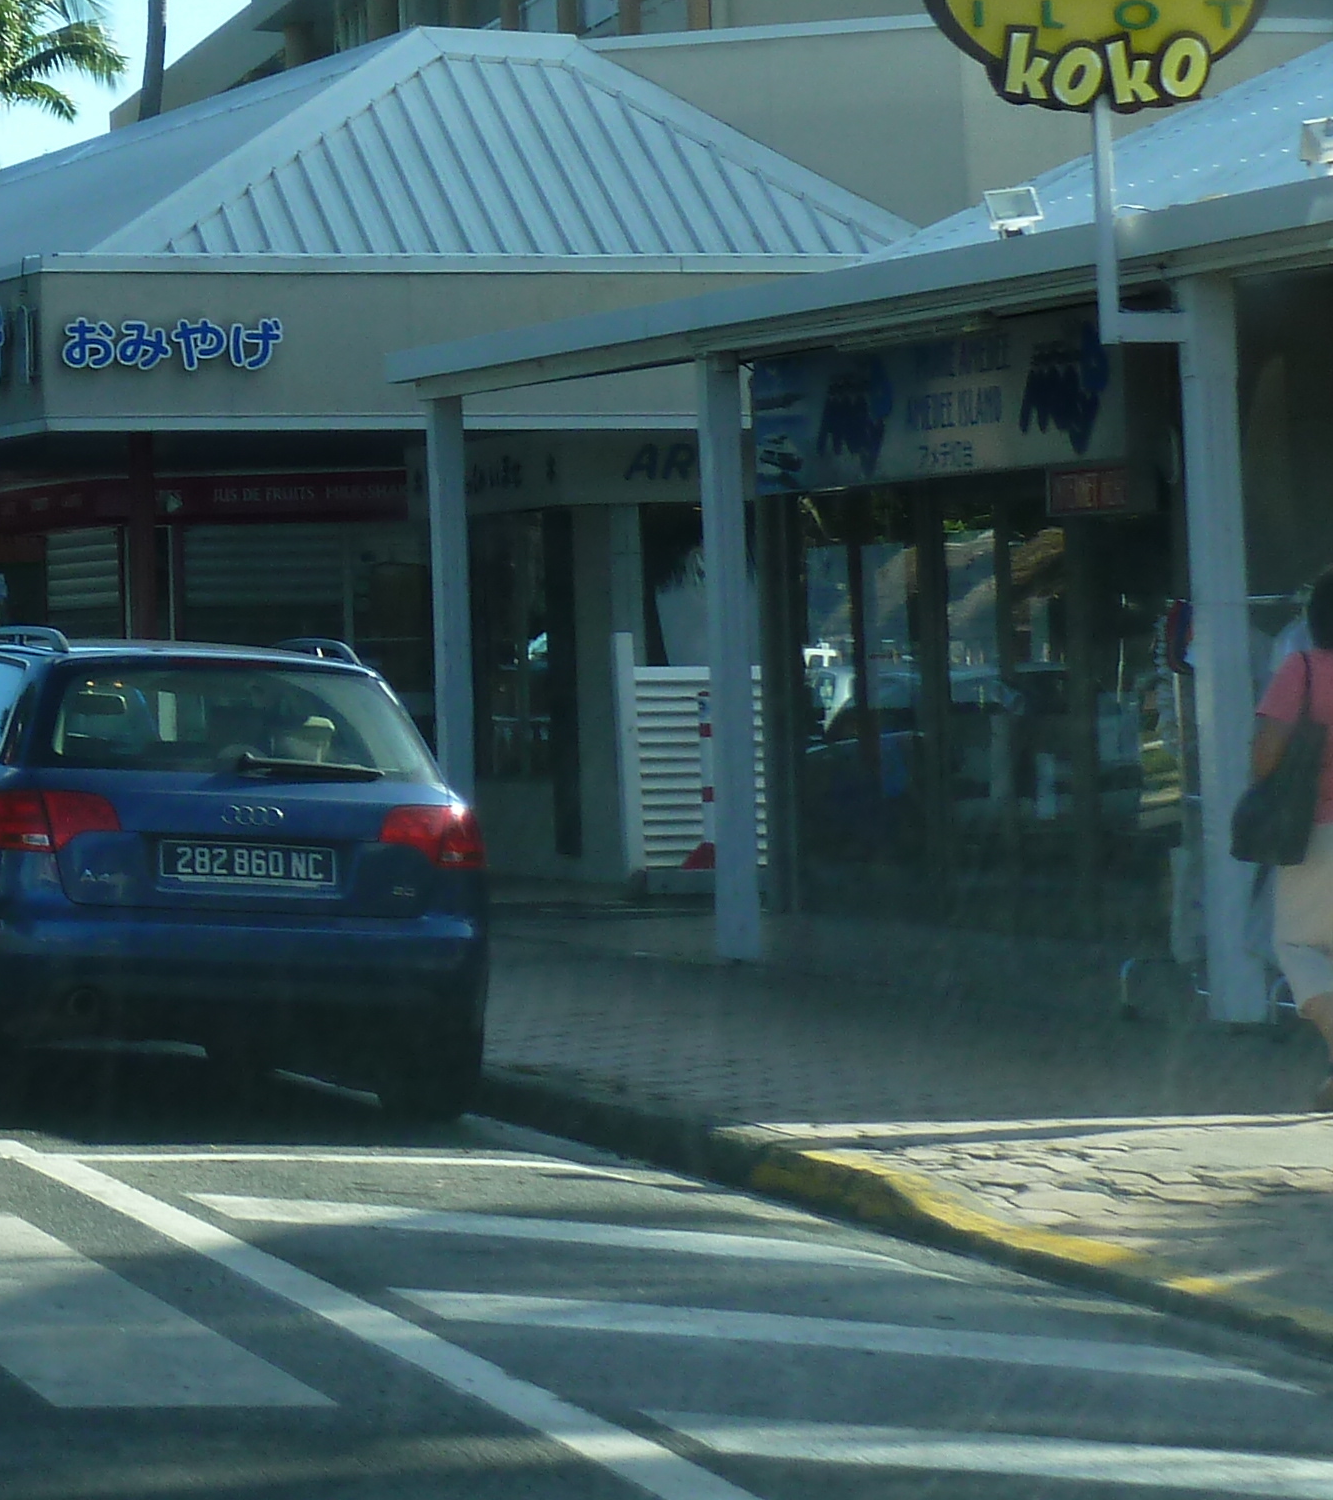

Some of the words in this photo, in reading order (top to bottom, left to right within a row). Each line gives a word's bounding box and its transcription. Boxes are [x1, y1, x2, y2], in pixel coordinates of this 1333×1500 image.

[970, 0, 1247, 30] ILOT
[61, 315, 284, 371] おみやげ
[623, 442, 699, 481] AR
[213, 487, 238, 504] JUS
[242, 487, 262, 503] DE
[266, 485, 315, 502] FRUITS
[175, 846, 229, 875] 282
[233, 848, 284, 877] 860
[291, 852, 324, 880] NC
